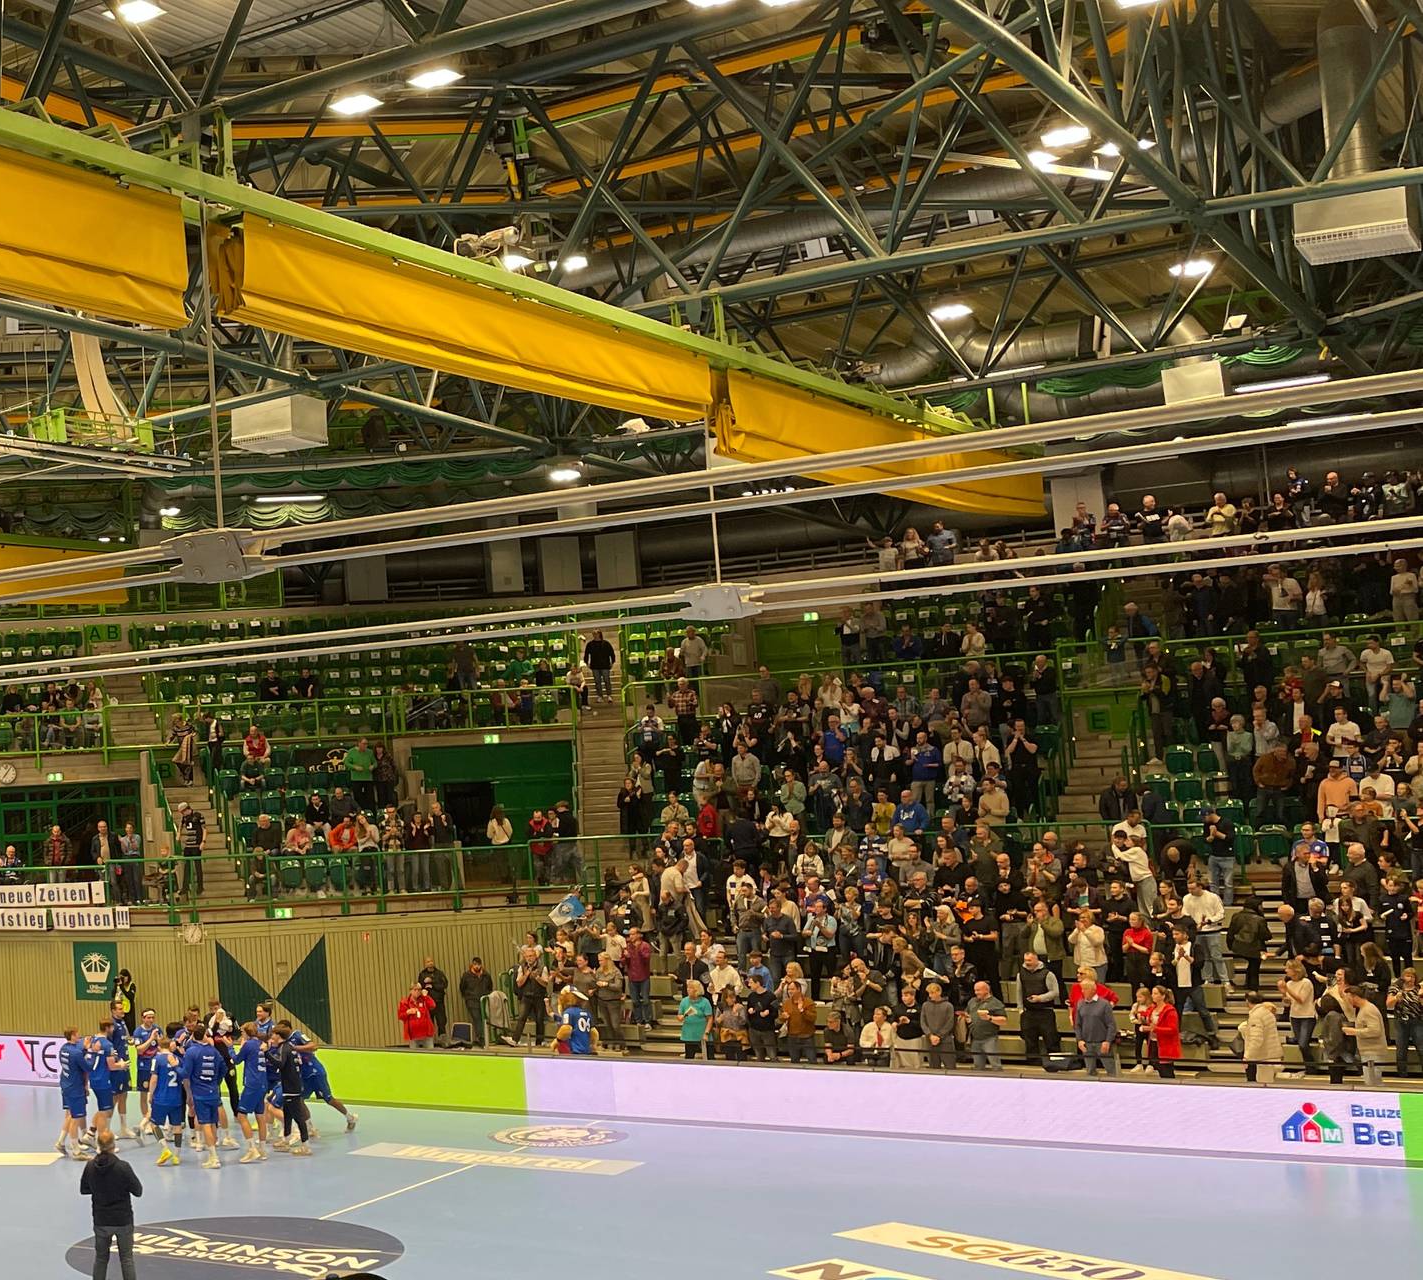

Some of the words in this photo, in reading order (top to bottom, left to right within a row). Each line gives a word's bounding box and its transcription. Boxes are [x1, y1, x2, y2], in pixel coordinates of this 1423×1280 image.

[89, 626, 102, 640] A
[107, 625, 119, 640] B
[1091, 711, 1107, 729] E
[0, 891, 32, 904] neue
[39, 888, 87, 902] Zeiten
[56, 911, 110, 928] fighten
[24, 1040, 58, 1073] TE
[167, 1071, 178, 1087] 2
[169, 1250, 269, 1265] SWORD
